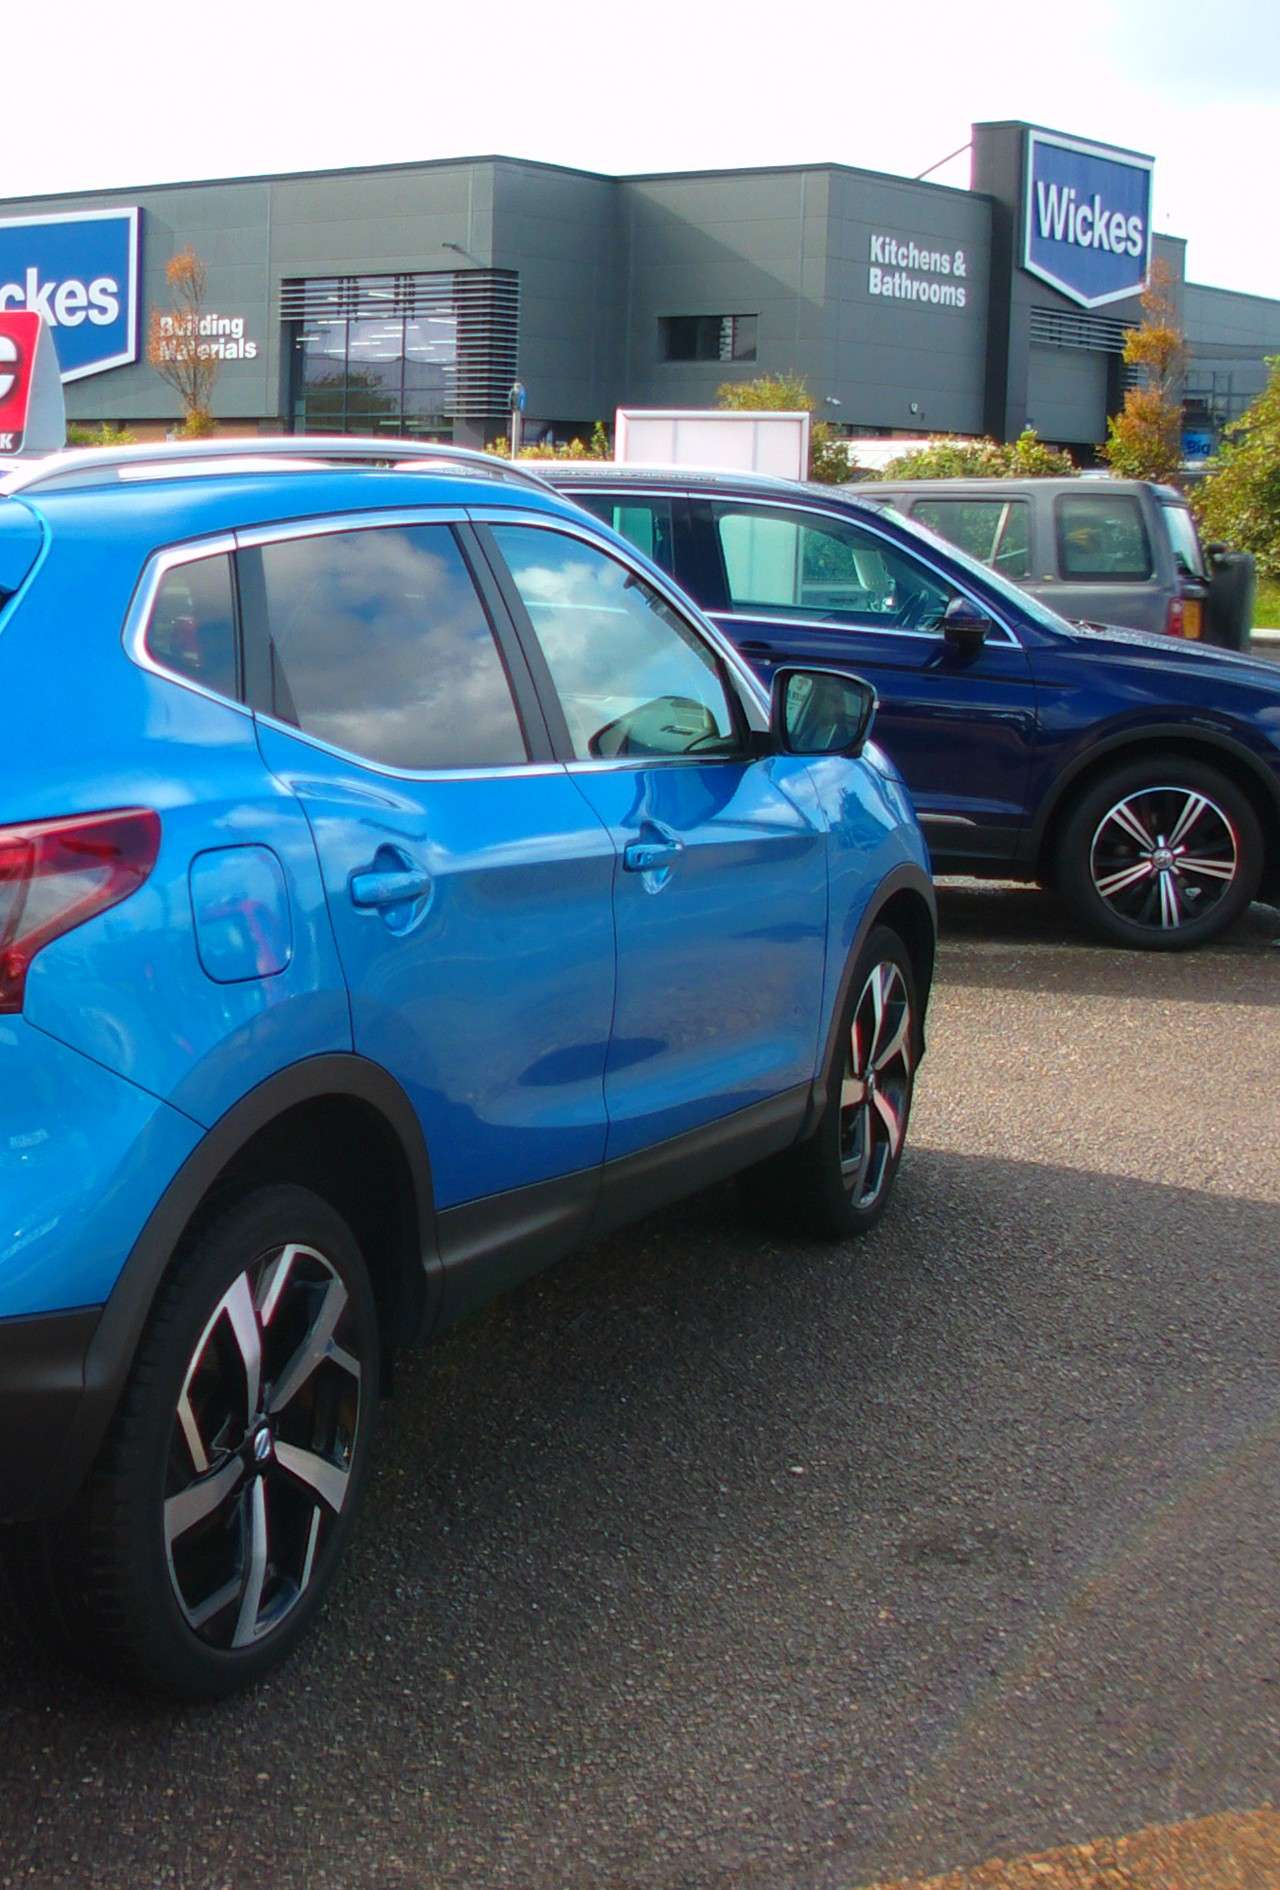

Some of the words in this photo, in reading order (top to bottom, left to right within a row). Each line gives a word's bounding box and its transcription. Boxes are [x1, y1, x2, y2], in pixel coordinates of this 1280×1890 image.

[1037, 181, 1143, 257] Wickes
[870, 234, 951, 275] Kitchens
[952, 250, 967, 277] &
[868, 267, 966, 307] Bathrooms
